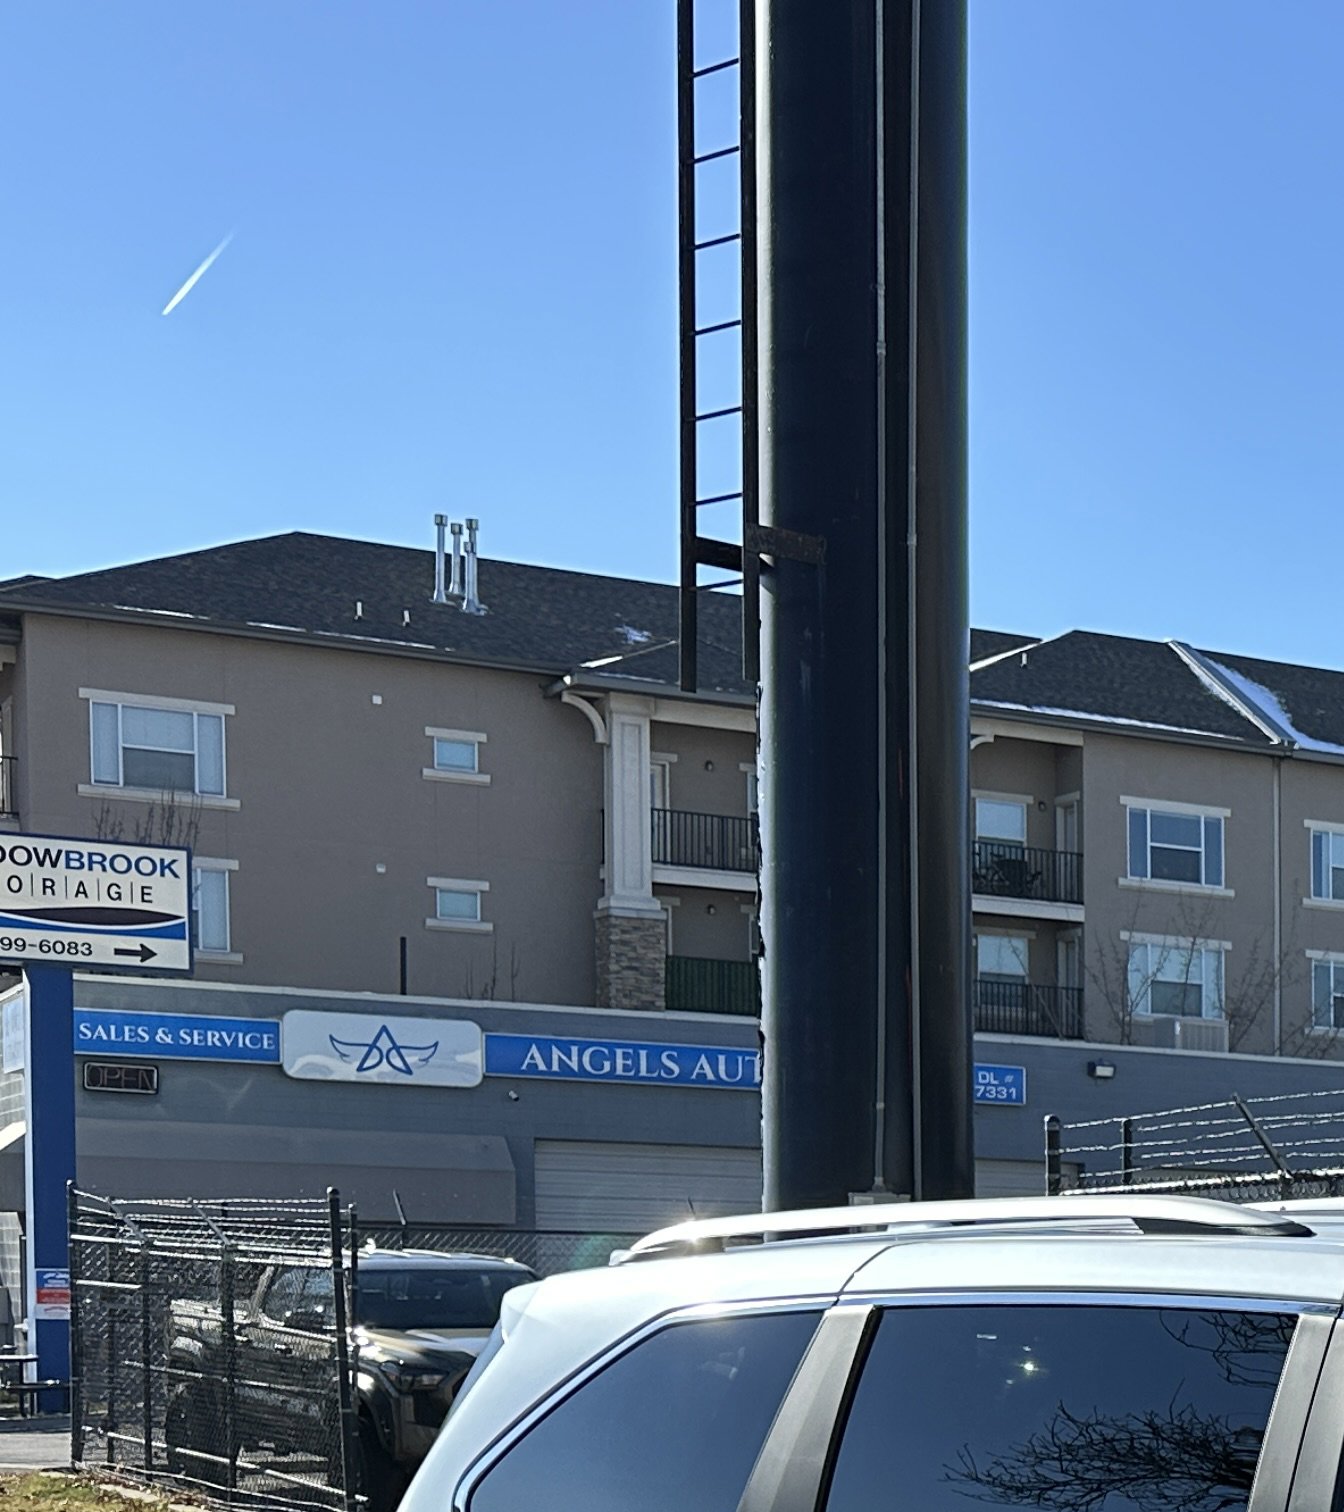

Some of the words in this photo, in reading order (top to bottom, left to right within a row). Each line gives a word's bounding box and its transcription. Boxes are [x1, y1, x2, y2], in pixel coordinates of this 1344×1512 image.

[0, 845, 180, 879] OWBROOK
[0, 936, 93, 956] 99-6083
[79, 1022, 149, 1043] SALES
[155, 1027, 174, 1045] &
[179, 1028, 275, 1050] SERVICE
[520, 1043, 681, 1079] ANGELS
[87, 1065, 156, 1090] OPEN
[978, 1071, 1000, 1084] DL
[974, 1085, 1016, 1100] 7331
